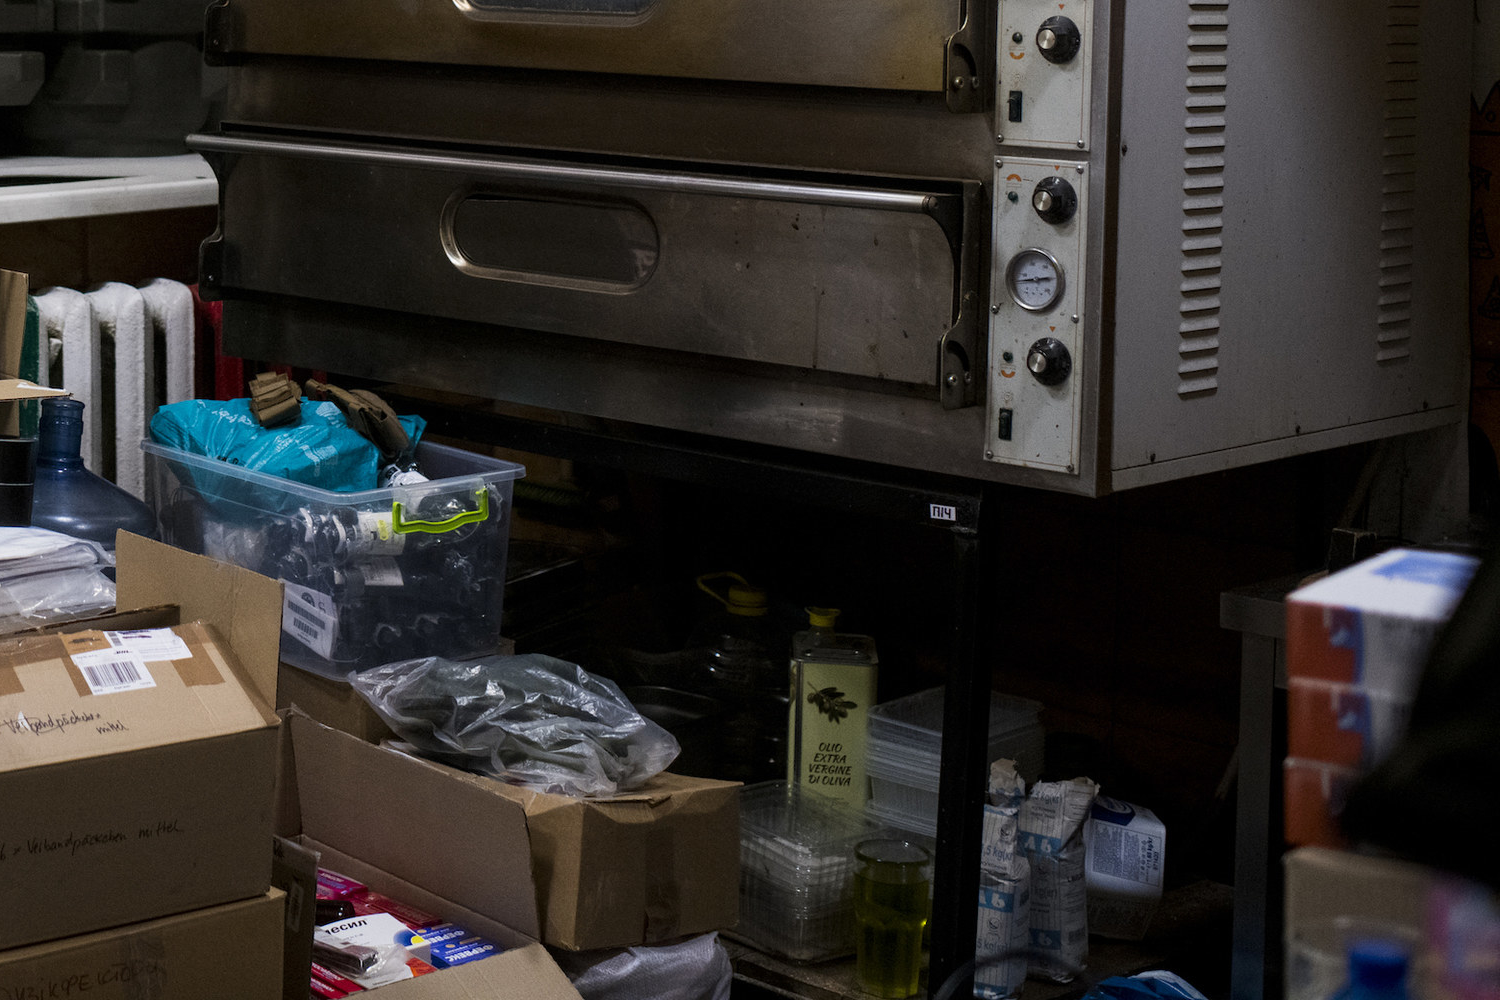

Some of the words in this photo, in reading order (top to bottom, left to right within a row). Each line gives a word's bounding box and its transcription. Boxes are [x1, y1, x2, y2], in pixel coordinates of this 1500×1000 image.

[932, 506, 952, 519] ПІЧ
[818, 742, 843, 753] OLIO
[813, 753, 847, 763] EXTRA
[808, 764, 853, 775] VERGINE
[808, 775, 820, 785] DI
[822, 776, 851, 786] OLIVA
